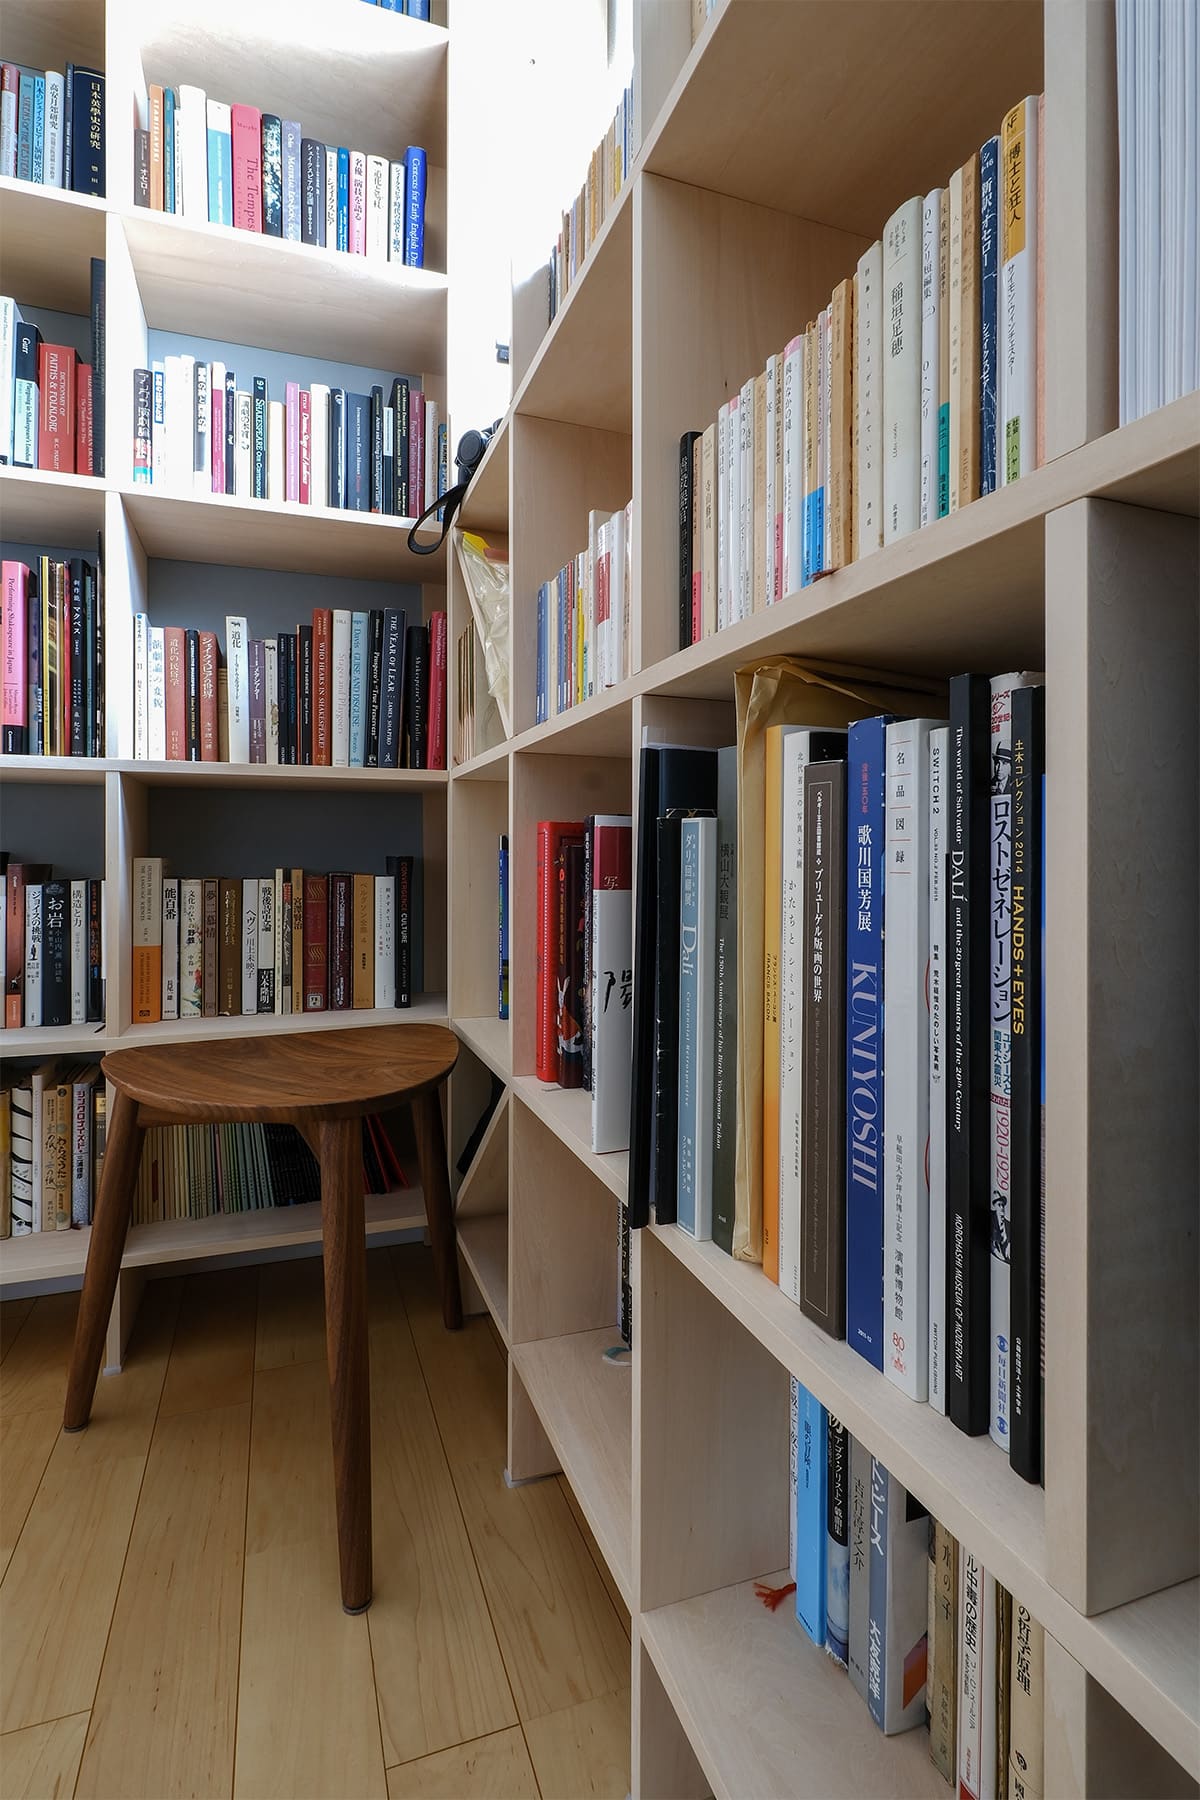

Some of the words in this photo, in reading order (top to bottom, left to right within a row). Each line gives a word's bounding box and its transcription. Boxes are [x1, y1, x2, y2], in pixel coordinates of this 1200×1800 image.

[246, 158, 259, 181] The
[411, 158, 421, 190] Contexts
[1008, 141, 1022, 229] 博士と狂人
[409, 202, 420, 221] Early
[409, 223, 419, 249] English
[891, 281, 904, 359] 稲垣足穂
[1007, 263, 1016, 376] サイモン・ウィンチェスター
[22, 337, 32, 354] Gurr
[50, 352, 58, 381] FAITHS
[48, 391, 58, 433] FOLKLORE
[7, 578, 15, 612] Performing
[7, 612, 15, 649] Shakespeare
[73, 605, 82, 635] マクベス
[231, 630, 242, 649] 道化
[318, 642, 326, 660] WHO
[353, 628, 362, 649] Davis
[389, 632, 398, 655] YEAR
[318, 662, 326, 686] HEARS
[352, 652, 362, 675] GUISE
[371, 651, 380, 684] Prospero's
[389, 656, 395, 665] OF
[318, 687, 325, 695] IN
[353, 675, 361, 689] AND
[387, 668, 397, 693] LEAR
[352, 693, 361, 728] DISGUISE
[955, 726, 964, 747] The
[932, 747, 940, 803] SWITCH
[955, 748, 963, 780] world
[955, 782, 963, 794] of
[894, 750, 907, 865] 名品図録
[932, 806, 940, 815] 2
[954, 795, 963, 845] Salvador
[1015, 738, 1025, 873] 土木コレクション2014
[684, 833, 693, 906] ダリ回顧展
[718, 842, 729, 921] 横山大観展
[856, 823, 873, 933] 歌川国芳展
[951, 849, 969, 903] DALÍ
[32, 890, 42, 944] ジョイスの挑戦
[47, 897, 66, 929] お岩
[73, 889, 83, 929] 構造と力
[165, 887, 177, 920] 能百番
[788, 879, 797, 945] かたちと
[955, 907, 963, 927] and
[992, 800, 1011, 1024] ロストゼネレーション
[246, 909, 257, 936] ヘヴン
[400, 913, 408, 944] CULTURE
[813, 867, 824, 1003] ブリューゲル版画の世界
[955, 928, 963, 946] the
[1013, 885, 1025, 961] HANDS
[246, 937, 255, 978] 川上未映子
[717, 937, 725, 952] The
[955, 946, 963, 960] 20
[717, 956, 725, 978] 150th
[954, 960, 962, 988] great
[716, 980, 725, 1027] Anniversary
[787, 956, 796, 1075] シミュレーション
[1013, 980, 1025, 1035] EYES
[716, 1041, 724, 1053] his
[955, 1033, 963, 1047] of
[955, 1047, 963, 1065] the
[716, 1054, 724, 1077] Birth:
[850, 960, 879, 1193] KUNIYOSHI
[954, 1066, 963, 1087] 20th
[715, 1079, 723, 1119] Yokoyama
[953, 1089, 963, 1133] Century
[715, 1122, 723, 1150] Taikan
[995, 1105, 1009, 1191] 1920-1929
[57, 1136, 68, 1179] わらべうた
[954, 1213, 963, 1267] MOROHASHI
[954, 1267, 963, 1307] MUSEUM
[954, 1307, 963, 1322] OF
[954, 1321, 963, 1361] MODERN
[954, 1360, 963, 1383] ART
